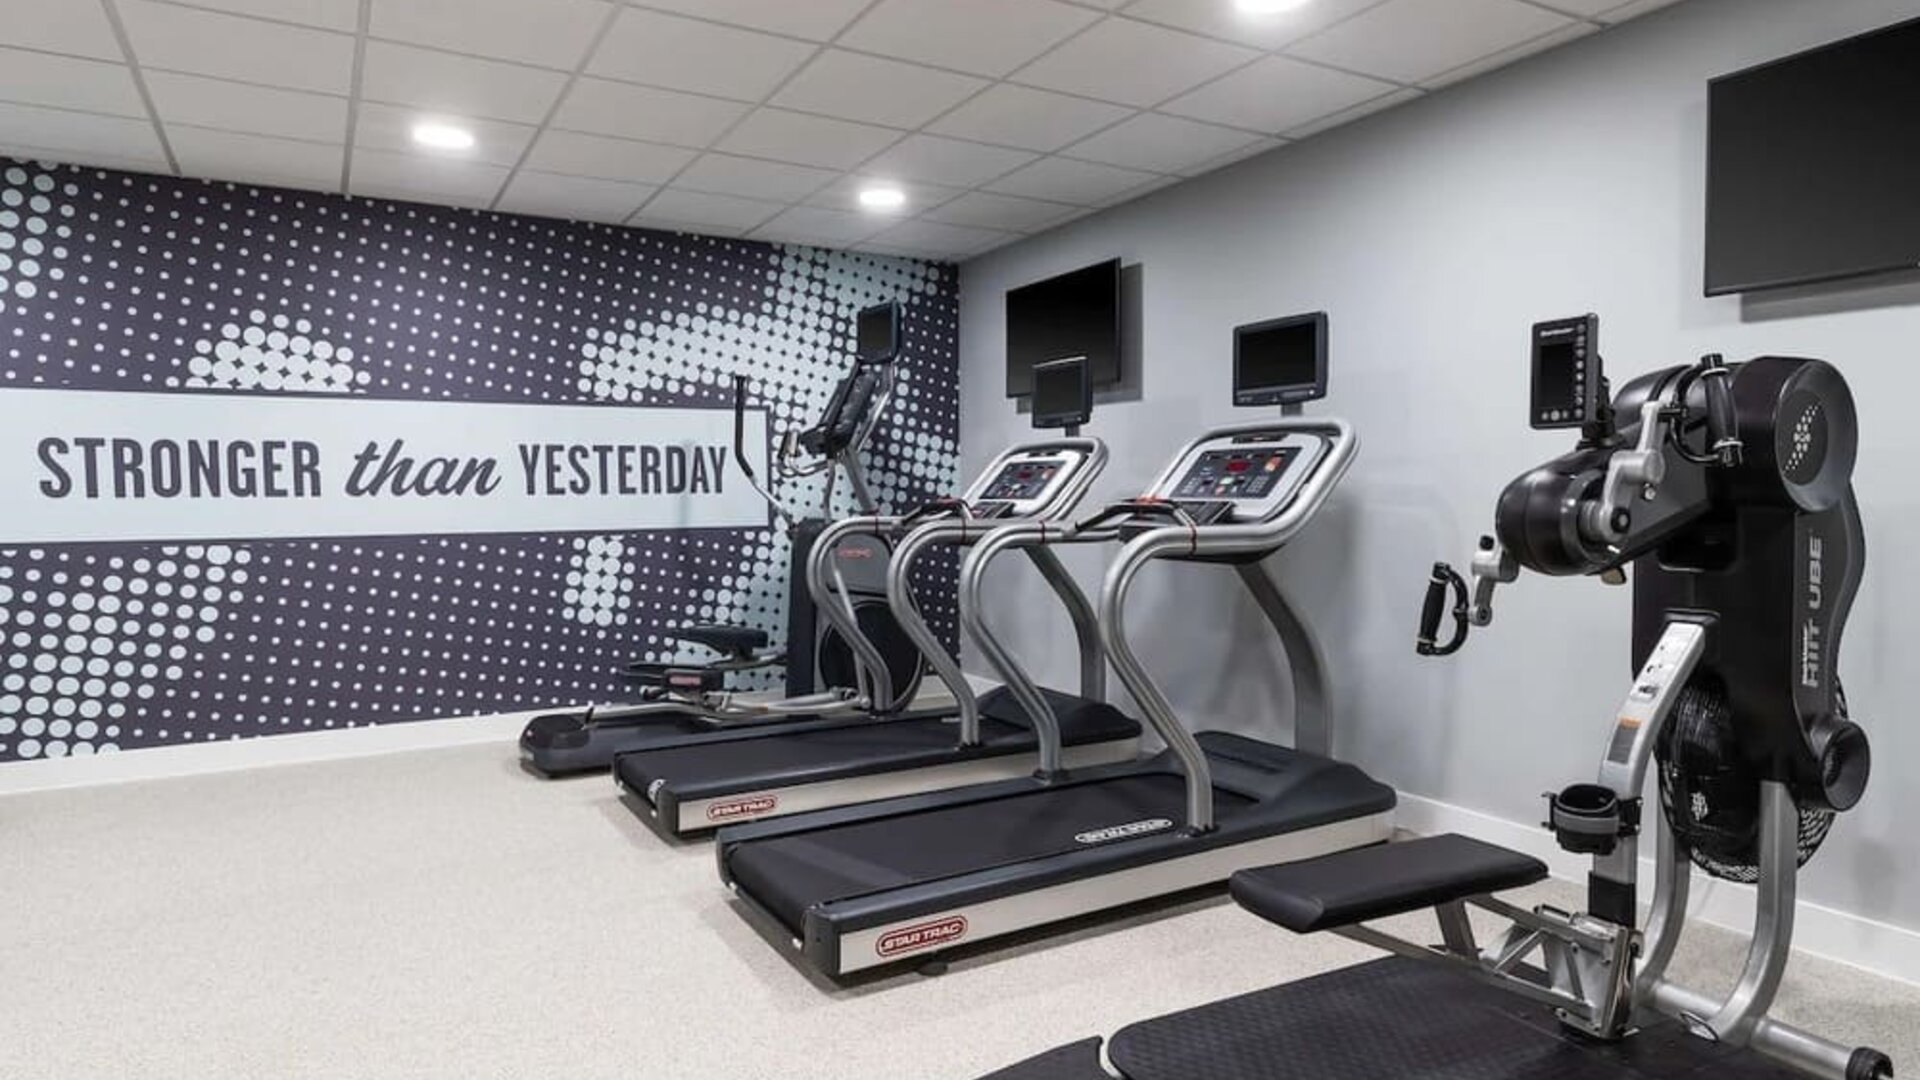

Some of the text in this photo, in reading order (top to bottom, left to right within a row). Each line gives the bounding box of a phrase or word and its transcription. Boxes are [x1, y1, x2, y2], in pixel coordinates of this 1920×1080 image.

[37, 437, 727, 498] STRONGER than YESTERDAY
[1809, 537, 1822, 609] UBE
[883, 921, 962, 950] STAR TRAC
